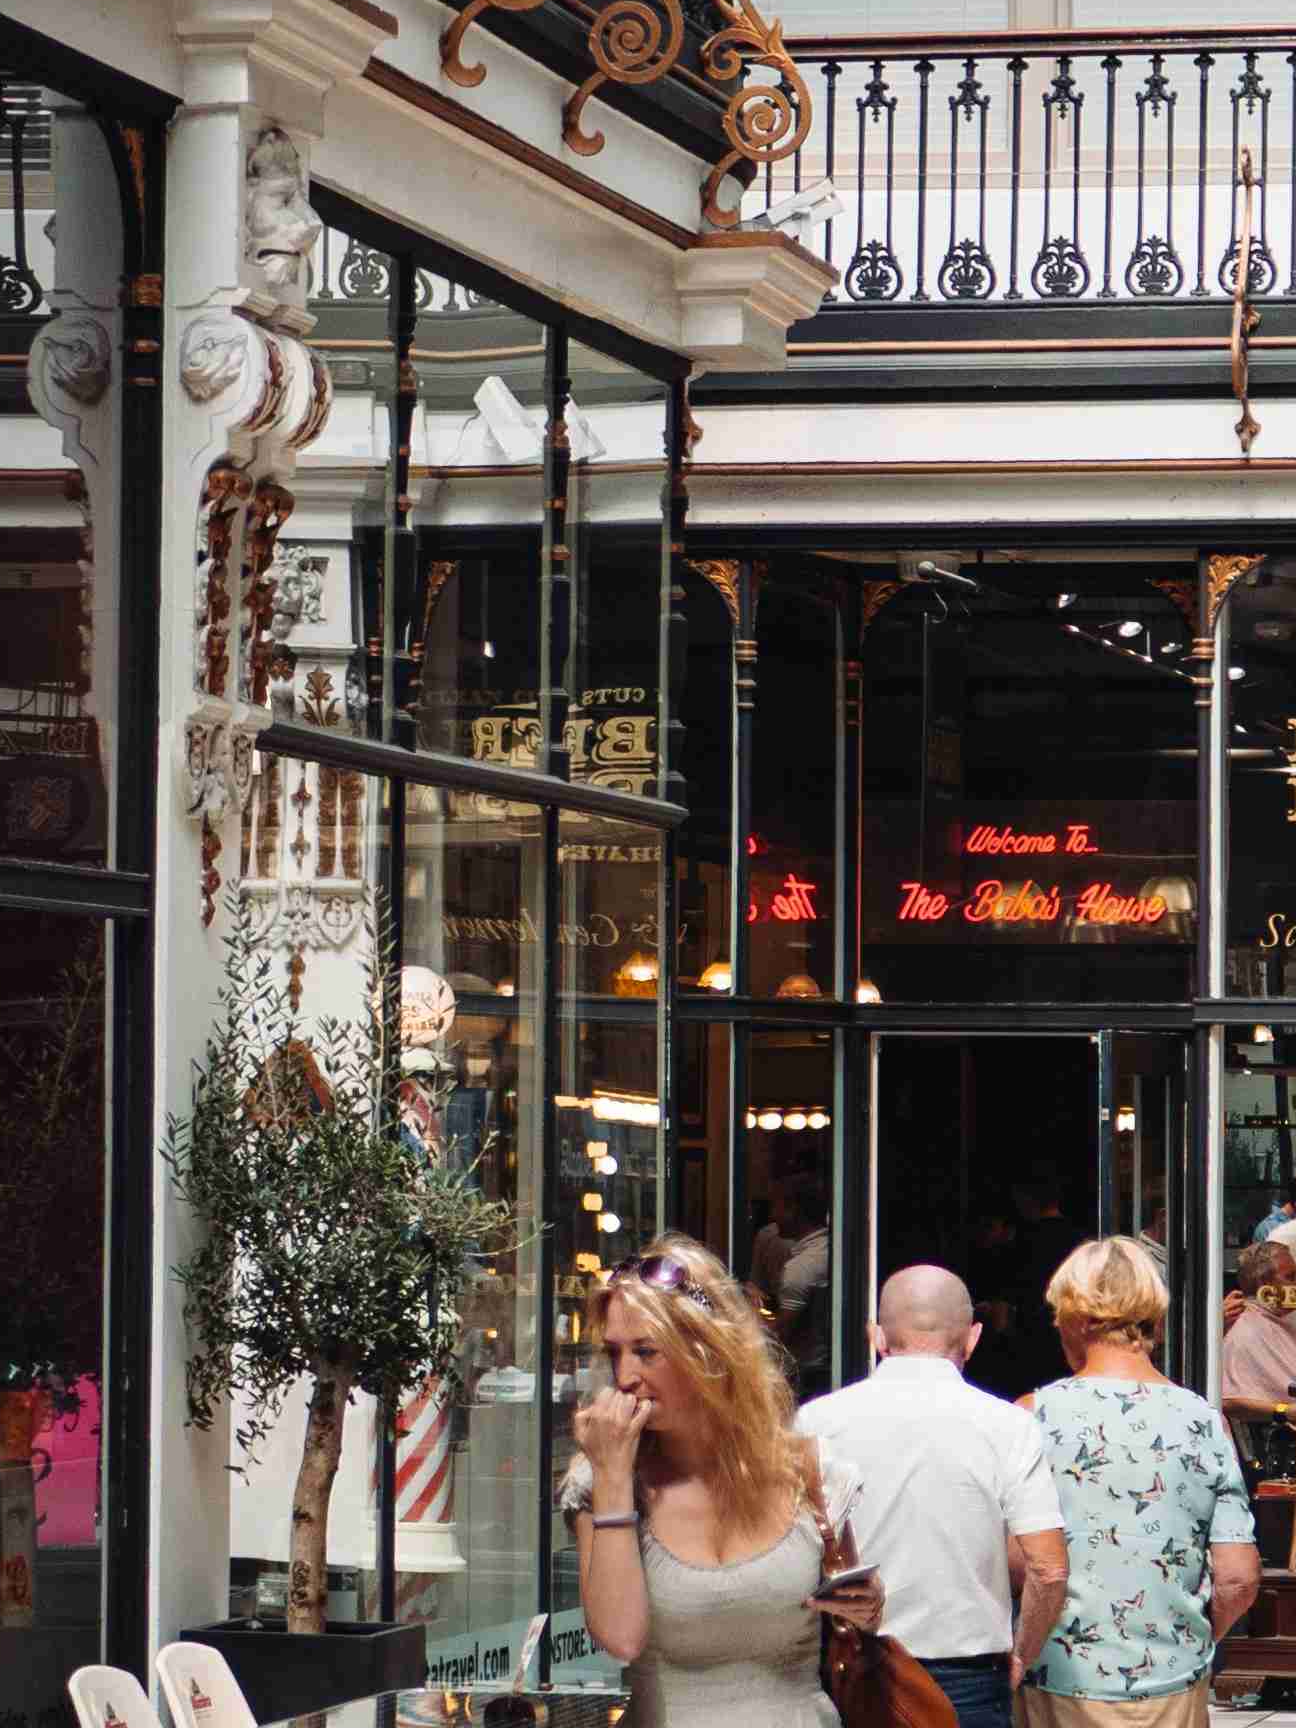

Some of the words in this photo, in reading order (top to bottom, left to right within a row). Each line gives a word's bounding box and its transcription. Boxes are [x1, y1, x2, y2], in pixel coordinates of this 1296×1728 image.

[966, 825, 1055, 855] Welcome
[898, 882, 947, 920] The
[964, 879, 1060, 922] Baba's
[1076, 882, 1168, 923] House
